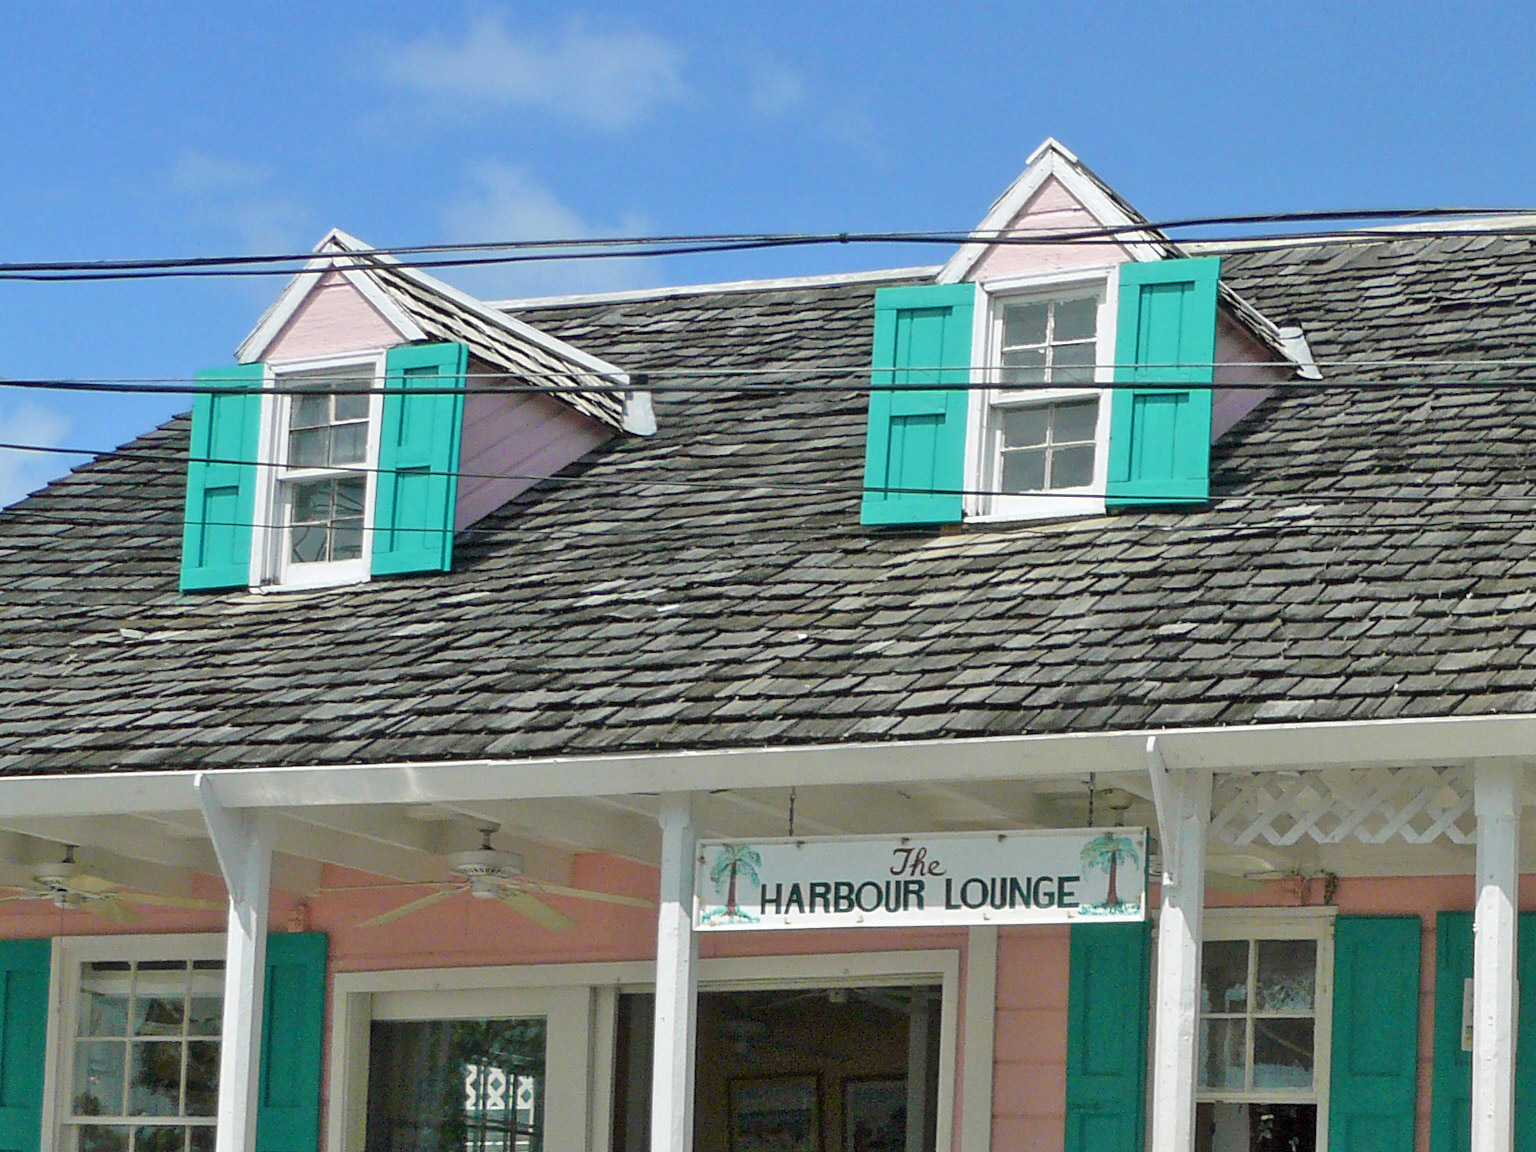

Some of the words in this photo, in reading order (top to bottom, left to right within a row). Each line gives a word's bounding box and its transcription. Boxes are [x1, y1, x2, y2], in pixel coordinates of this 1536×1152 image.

[890, 847, 947, 877] The
[760, 879, 926, 915] HARBOUR
[945, 875, 1081, 910] LOUNGE
